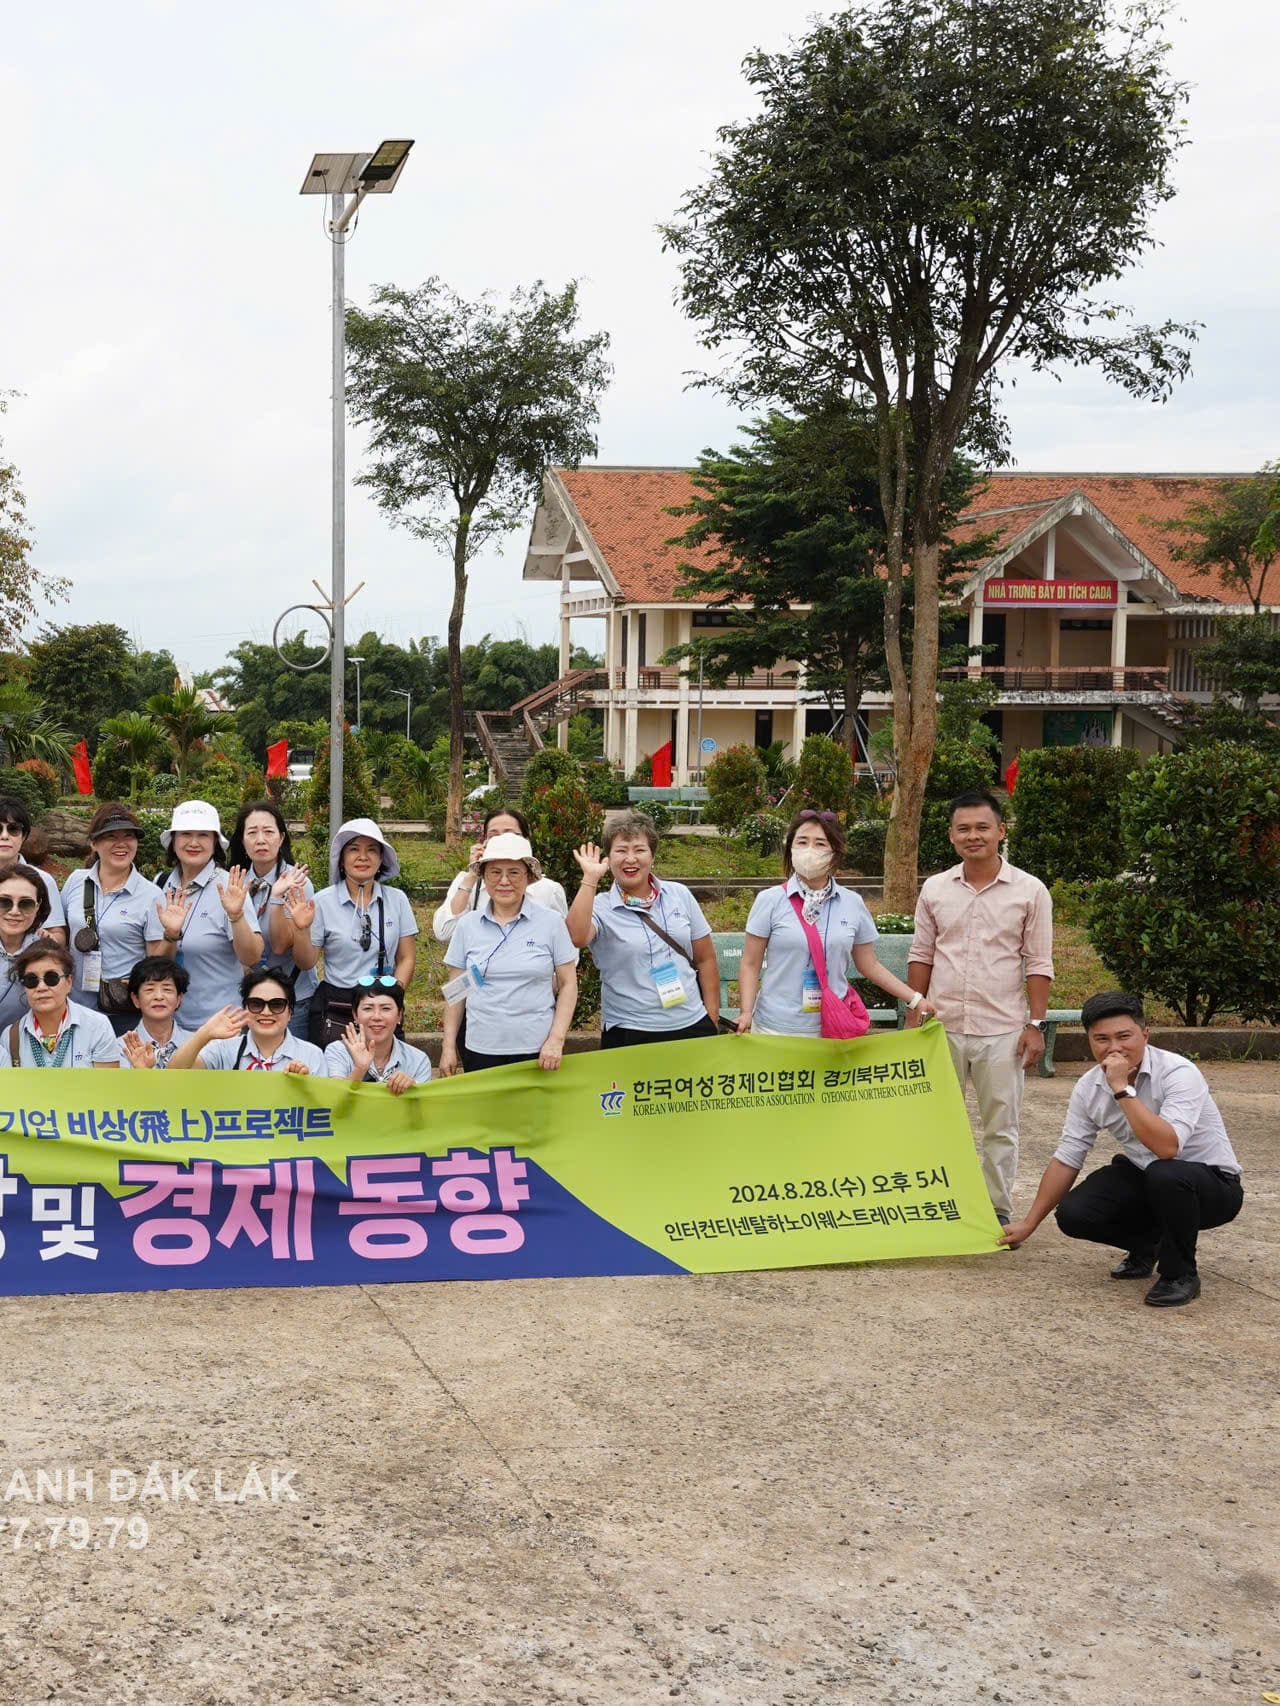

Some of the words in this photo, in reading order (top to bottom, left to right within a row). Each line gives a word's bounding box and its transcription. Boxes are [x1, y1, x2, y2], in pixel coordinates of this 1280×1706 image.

[1038, 583, 1056, 599] BÀY
[1068, 583, 1087, 600] TÍCH
[1089, 585, 1112, 600] CADA
[633, 1070, 815, 1102] 한국여성경제인협회
[823, 1058, 926, 1088] 경기북부지회
[633, 1102, 667, 1116] KOREAN
[667, 1100, 700, 1113] WOMEN
[700, 1096, 765, 1111] ENTREPRENEURS
[765, 1092, 815, 1107] ASSOCIATION
[821, 1089, 857, 1104] GYEONGGI
[857, 1086, 897, 1101] NORTHERN
[898, 1081, 933, 1097] CHAPTER
[729, 1176, 866, 1203] 2024.8.28.(수)
[872, 1171, 912, 1193] 오후
[915, 1165, 950, 1189] 5시
[31, 1185, 99, 1262] 및
[119, 1158, 316, 1266] 경제
[338, 1149, 531, 1260] 동향
[664, 1199, 961, 1242] 인터컨티넨탈하노이웨스트레이크호텔
